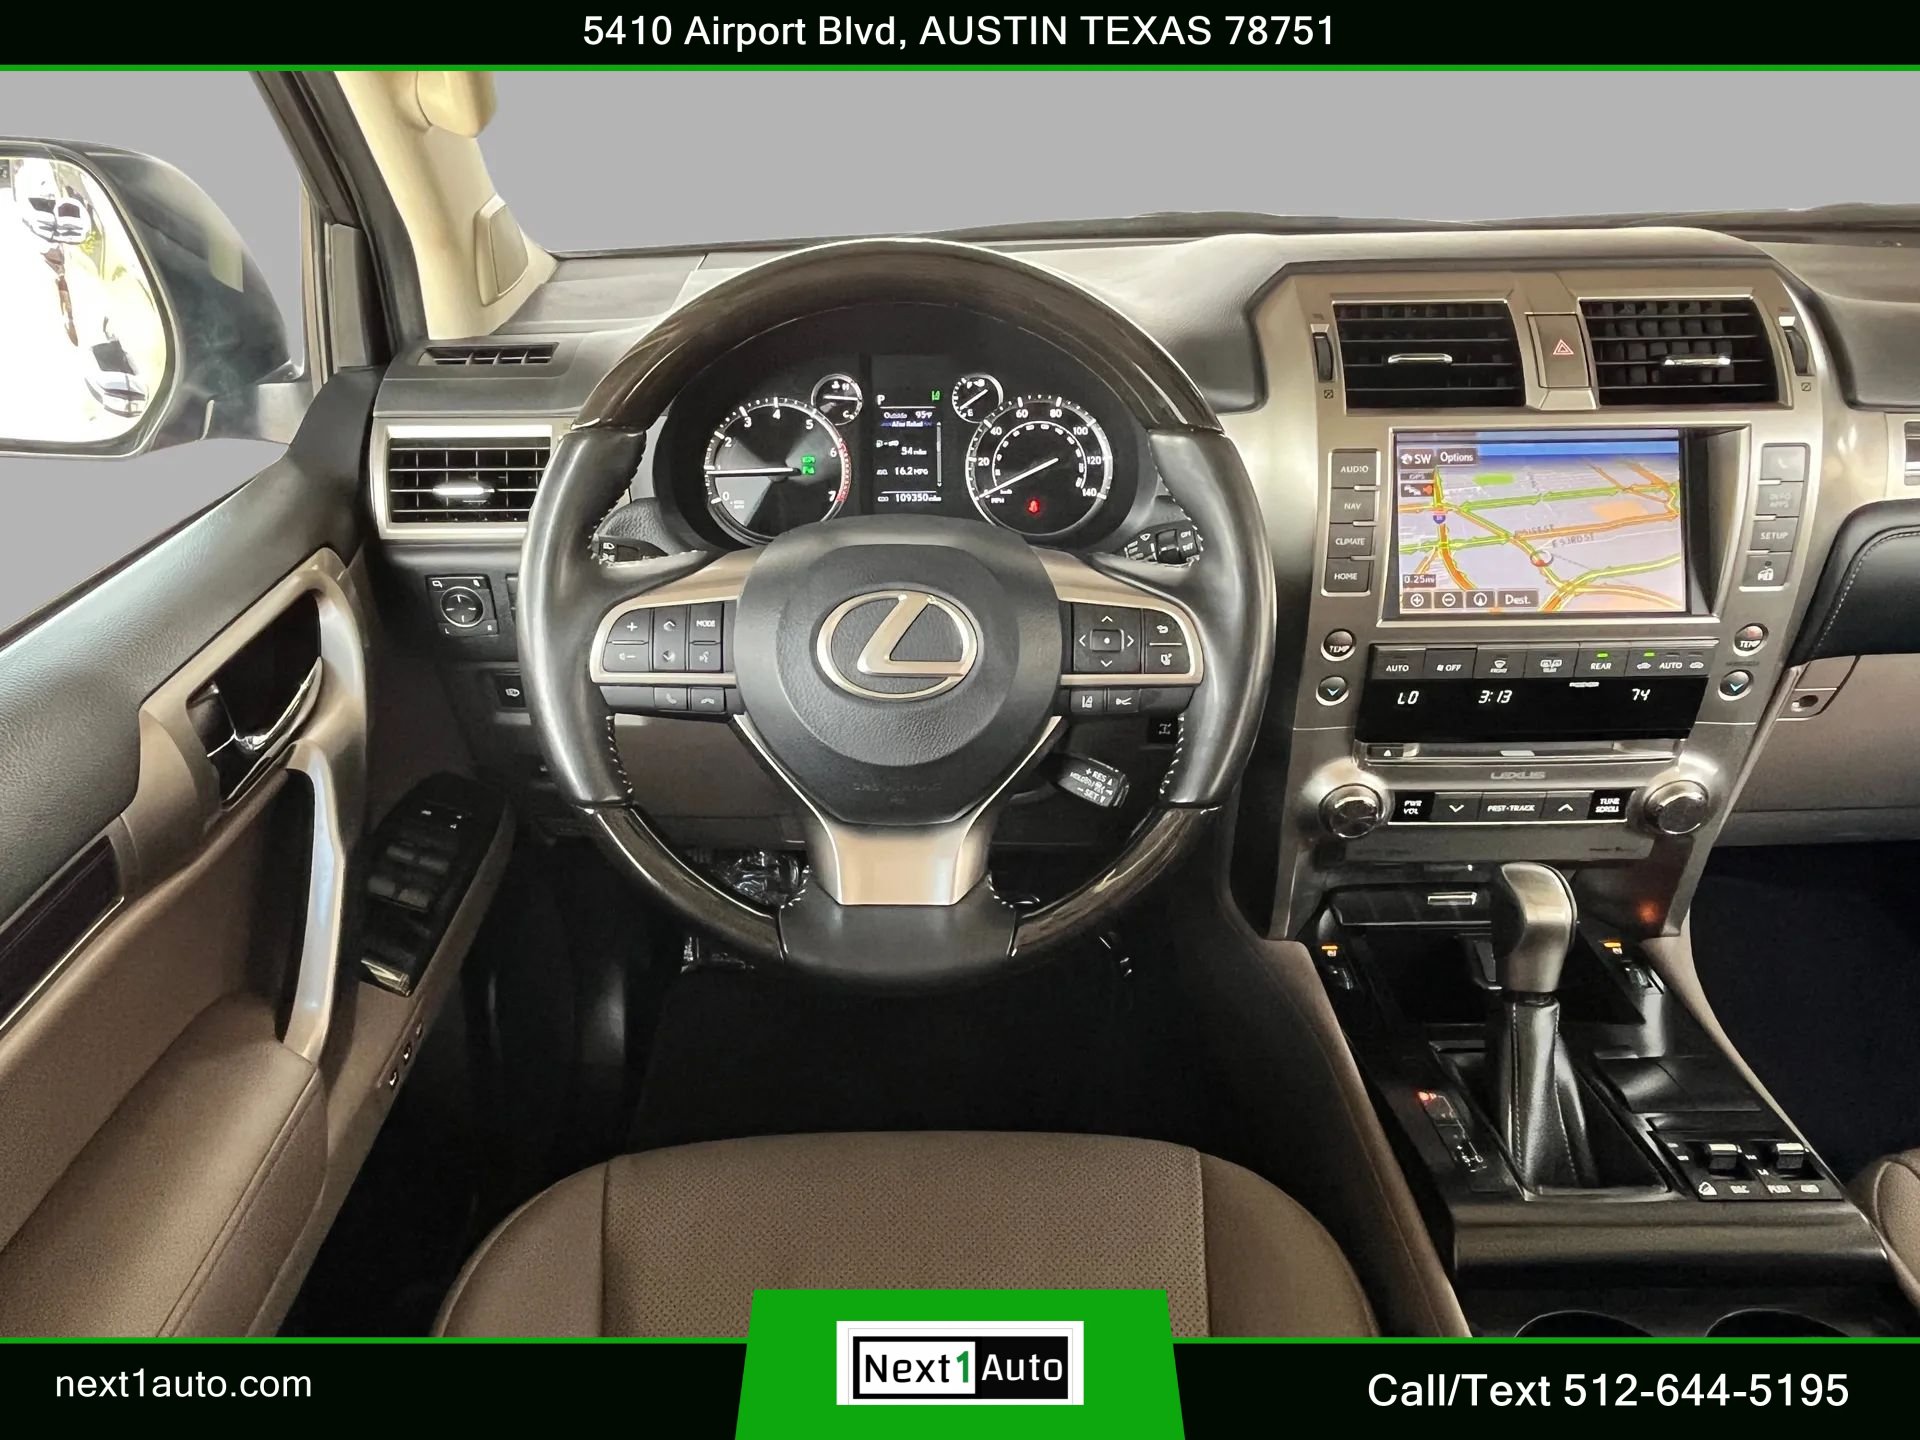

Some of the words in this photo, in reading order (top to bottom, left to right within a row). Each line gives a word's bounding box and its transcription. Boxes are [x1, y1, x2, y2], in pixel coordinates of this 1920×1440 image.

[876, 394, 886, 406] P
[772, 408, 781, 420] 4
[968, 409, 974, 417] E
[1016, 410, 1028, 418] 60
[1050, 410, 1062, 418] 80
[744, 416, 752, 428] 3
[806, 419, 814, 430] 5
[990, 426, 1002, 436] 40
[1072, 426, 1089, 436] 100
[724, 436, 732, 448] 2
[830, 448, 837, 458] 6
[1440, 451, 1474, 464] Options
[978, 457, 990, 466] 20
[1086, 456, 1102, 465] 120
[1414, 454, 1432, 464] SW
[895, 466, 913, 476] 16.2
[1340, 465, 1370, 474] AUDIO
[722, 491, 730, 502] 0
[828, 490, 837, 502] 7
[895, 494, 928, 502] 109350
[1082, 488, 1097, 498] 140
[1344, 502, 1362, 510] NAV
[1760, 531, 1789, 540] SETUP
[1335, 537, 1366, 546] CLIMATE
[1334, 572, 1358, 580] HOME
[1505, 594, 1531, 605] Dest.
[696, 620, 716, 628] MODE
[1740, 640, 1760, 648] TEMP
[1386, 664, 1410, 672] AUTO
[1445, 664, 1462, 672] OFF
[1590, 662, 1612, 670] REAR
[1659, 662, 1683, 670] AUTO
[1396, 690, 1420, 705] LO
[1478, 690, 1513, 704] 3:13
[1631, 688, 1651, 701] 74
[1092, 770, 1107, 782] RES
[1490, 771, 1547, 780] LEXUS
[1084, 788, 1099, 800] SET
